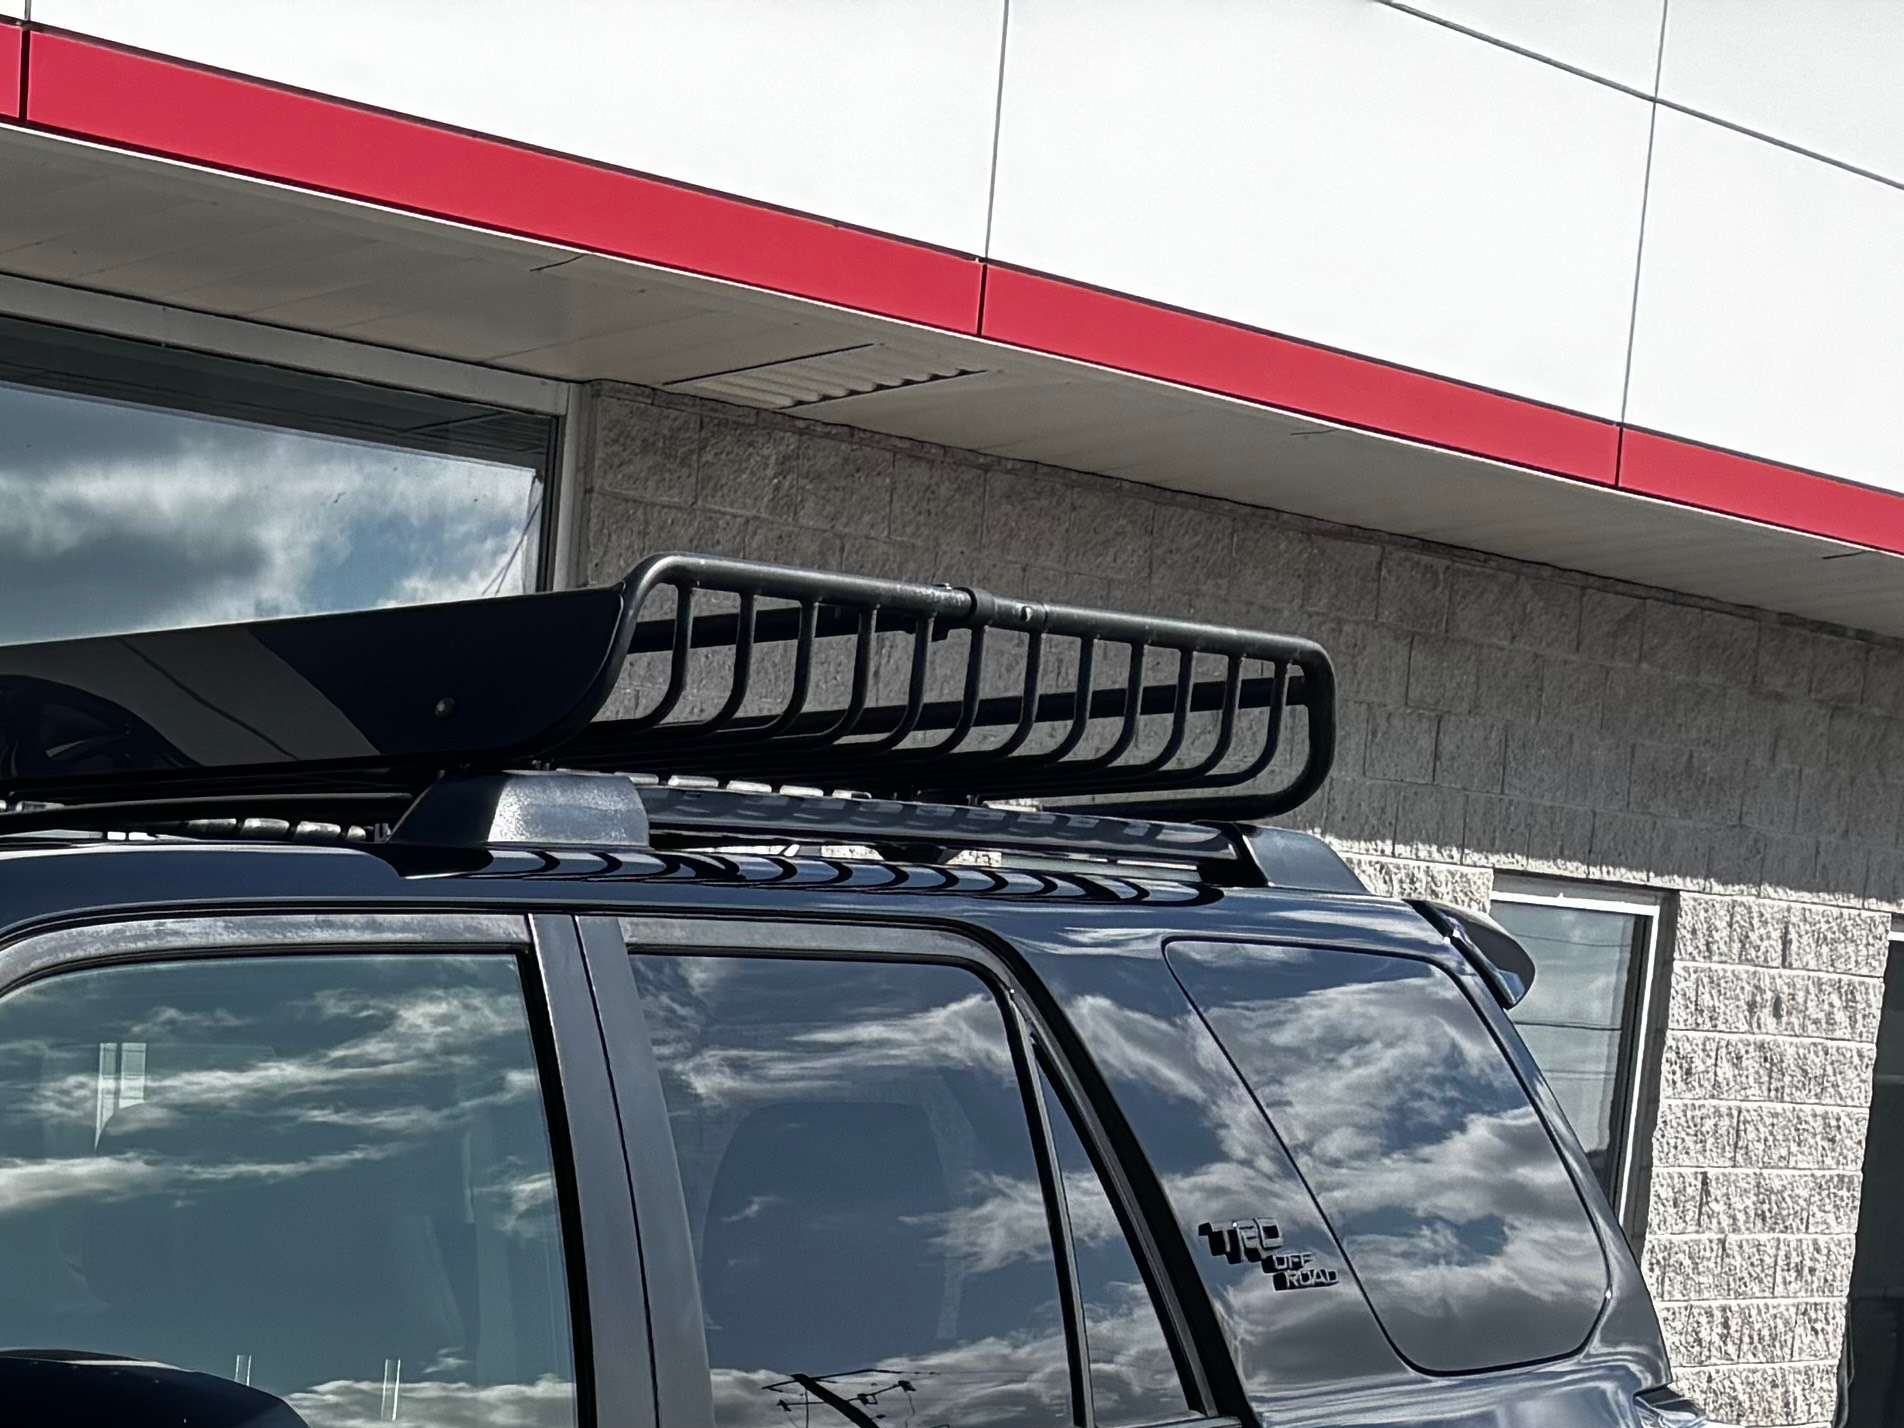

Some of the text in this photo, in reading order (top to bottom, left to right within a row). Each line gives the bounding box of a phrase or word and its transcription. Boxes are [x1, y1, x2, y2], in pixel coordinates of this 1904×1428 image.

[1200, 1216, 1284, 1264] TRD
[1271, 1252, 1314, 1272] OFF
[1283, 1268, 1340, 1290] ROAD
